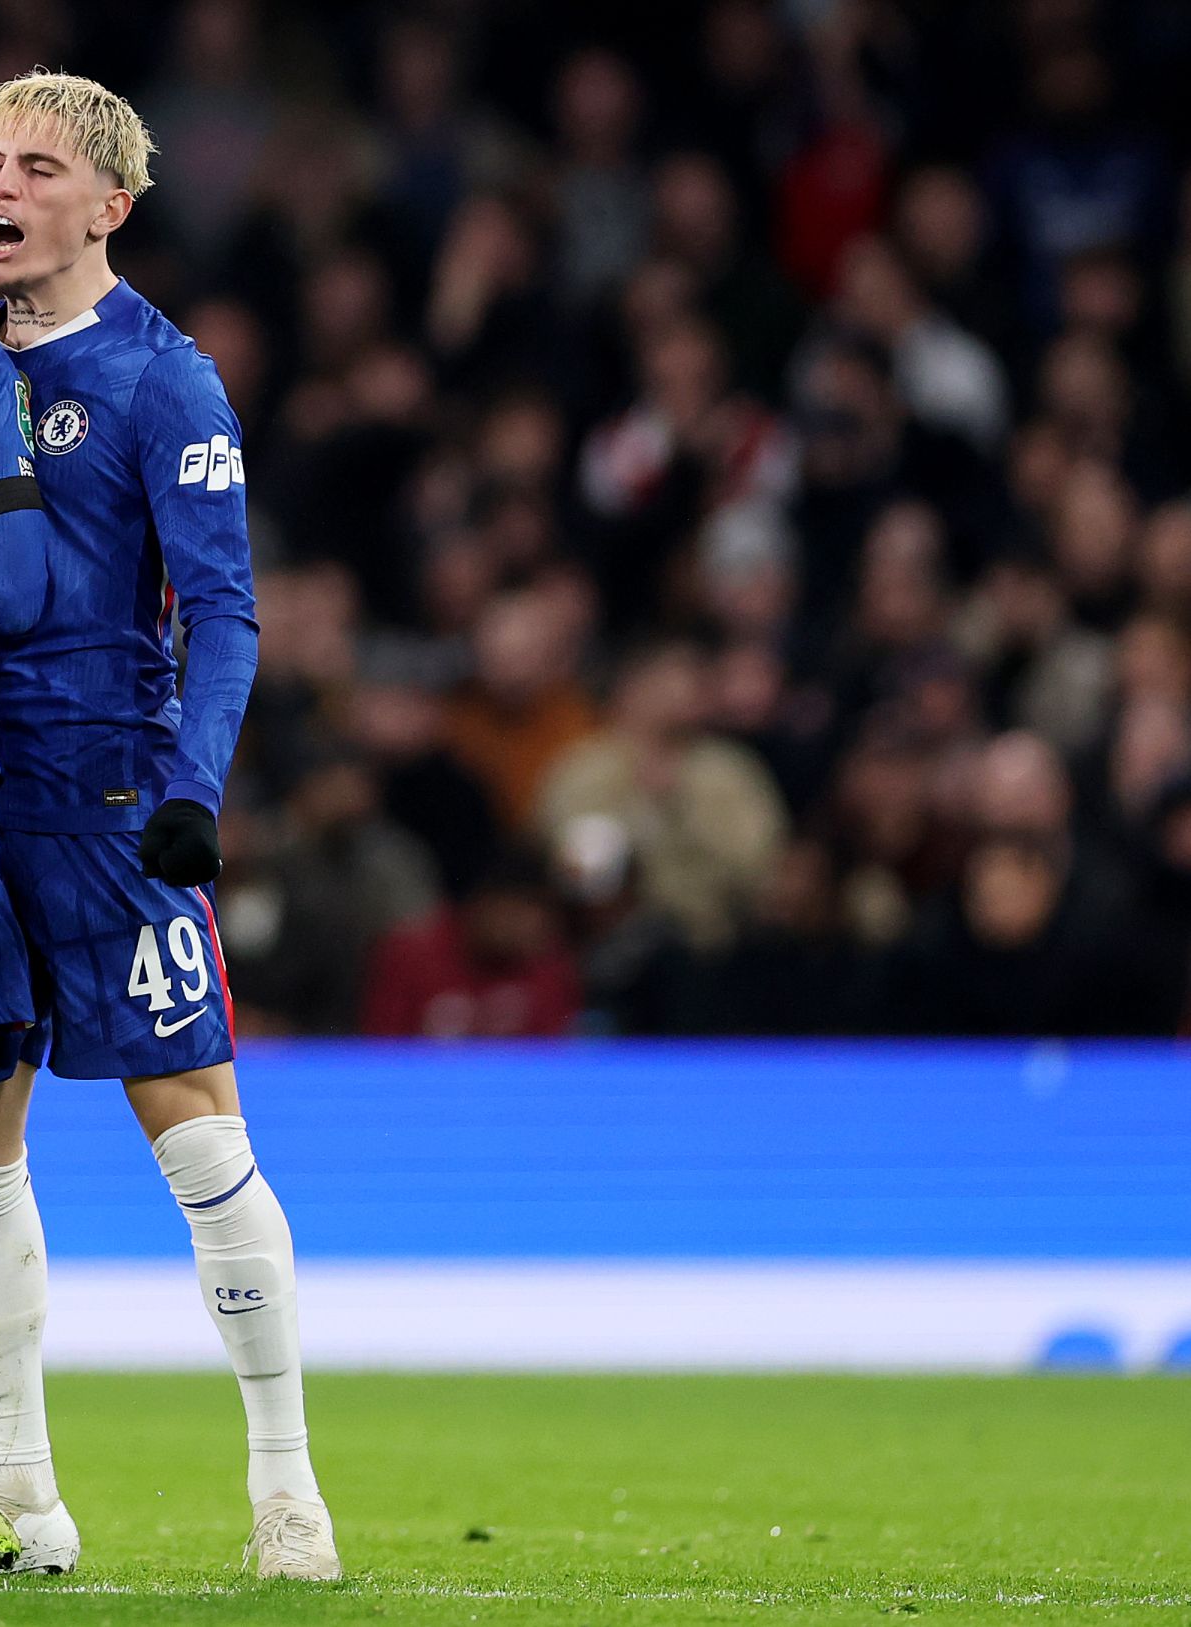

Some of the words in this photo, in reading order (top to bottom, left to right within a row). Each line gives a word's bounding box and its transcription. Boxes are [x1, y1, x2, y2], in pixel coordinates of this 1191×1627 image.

[50, 403, 82, 415] CHELSEA
[127, 915, 209, 1012] 49
[215, 1286, 264, 1301] CFC
